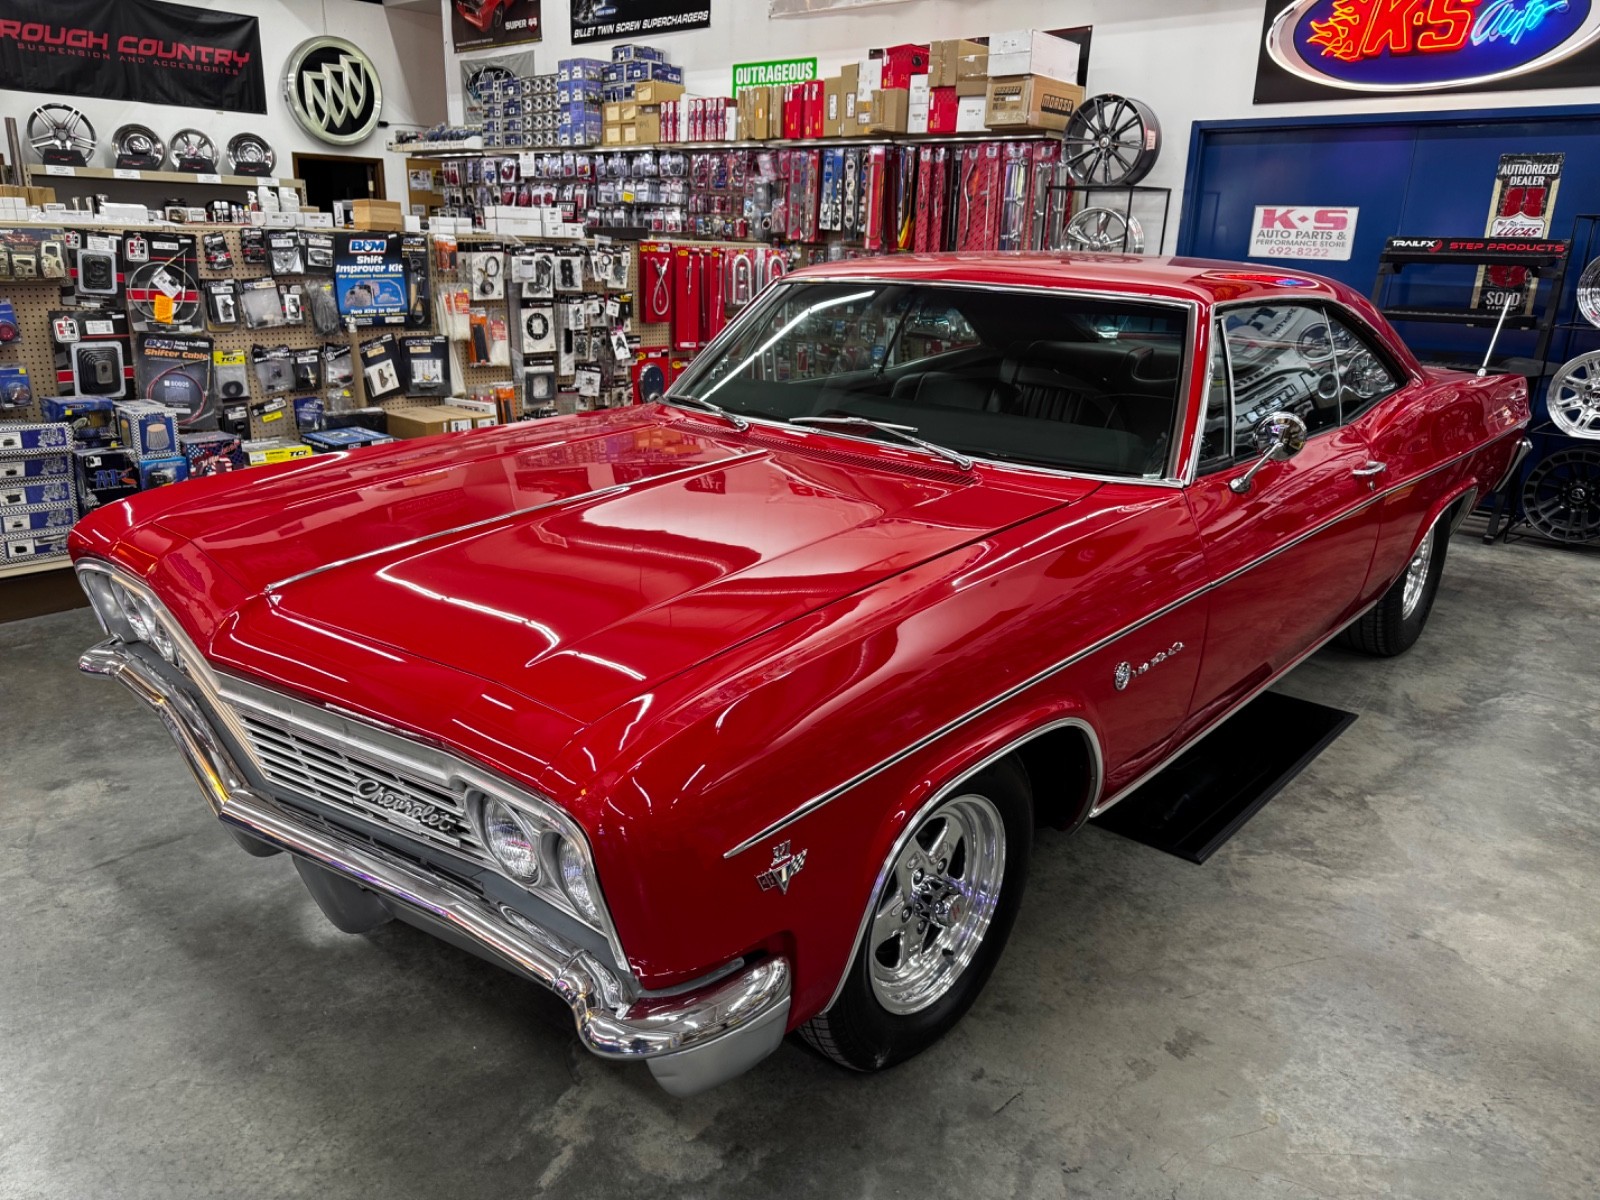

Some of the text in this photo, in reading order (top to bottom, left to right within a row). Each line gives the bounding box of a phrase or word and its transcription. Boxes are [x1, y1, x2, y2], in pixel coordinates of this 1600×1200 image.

[505, 19, 527, 31] SUPER
[574, 10, 709, 38] BILLET TWIN SCREW SUPERCHARGERS
[0, 18, 250, 68] ROUGH COUNTRY
[17, 42, 239, 75] SUSPENSION AND ACCESSORIES
[735, 61, 814, 85] OUTRAGEOUS
[1500, 163, 1559, 176] AUTHORIZED
[1509, 175, 1545, 186] DEALER
[1257, 230, 1347, 240] AUTO PARTS &
[1496, 227, 1541, 237] LUCAS
[1255, 239, 1317, 247] PERFORMANCE
[1392, 240, 1565, 252] TRAILFX STEP PRODUCTS
[1268, 246, 1329, 257] 692-8222
[356, 255, 383, 264] Shift
[336, 264, 404, 273] Improver Kit
[144, 348, 208, 359] Shifter Cable
[356, 778, 457, 831] Chevrolet
